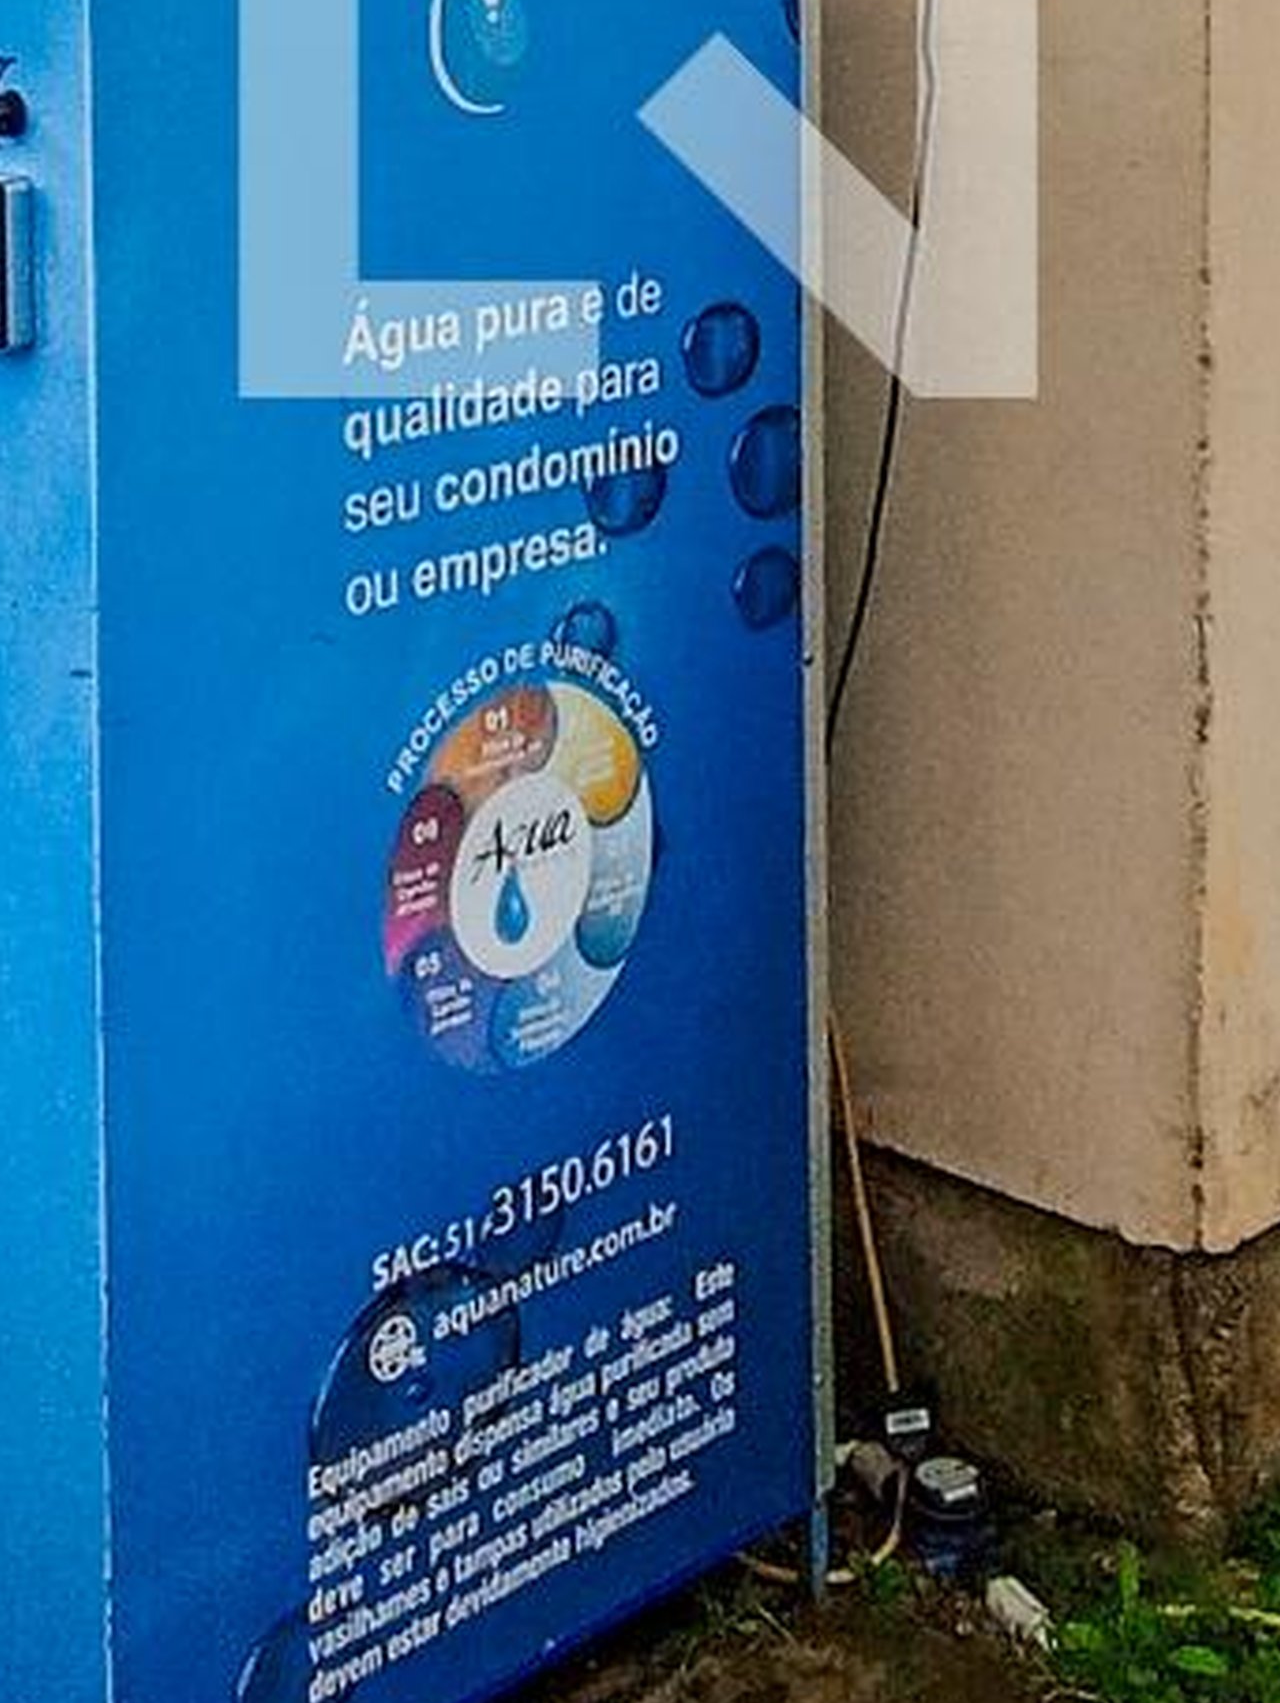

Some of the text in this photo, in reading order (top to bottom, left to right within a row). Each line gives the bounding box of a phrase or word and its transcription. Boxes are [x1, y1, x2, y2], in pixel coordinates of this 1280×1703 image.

[343, 268, 663, 371] Água pura e de
[343, 355, 661, 461] qualidade para
[344, 484, 421, 533] seu
[345, 519, 609, 617] ou empresa.
[386, 656, 499, 795] PROCESSO
[503, 642, 535, 672] DE
[540, 639, 658, 749] PURIFICAÇÃO
[432, 1200, 677, 1341] aquanature.com.br
[379, 1545, 417, 1586] ser
[429, 1511, 480, 1567] para
[491, 1453, 585, 1523] consumo
[391, 1504, 419, 1539] de
[426, 1475, 470, 1520] sais
[477, 1458, 504, 1492] ou
